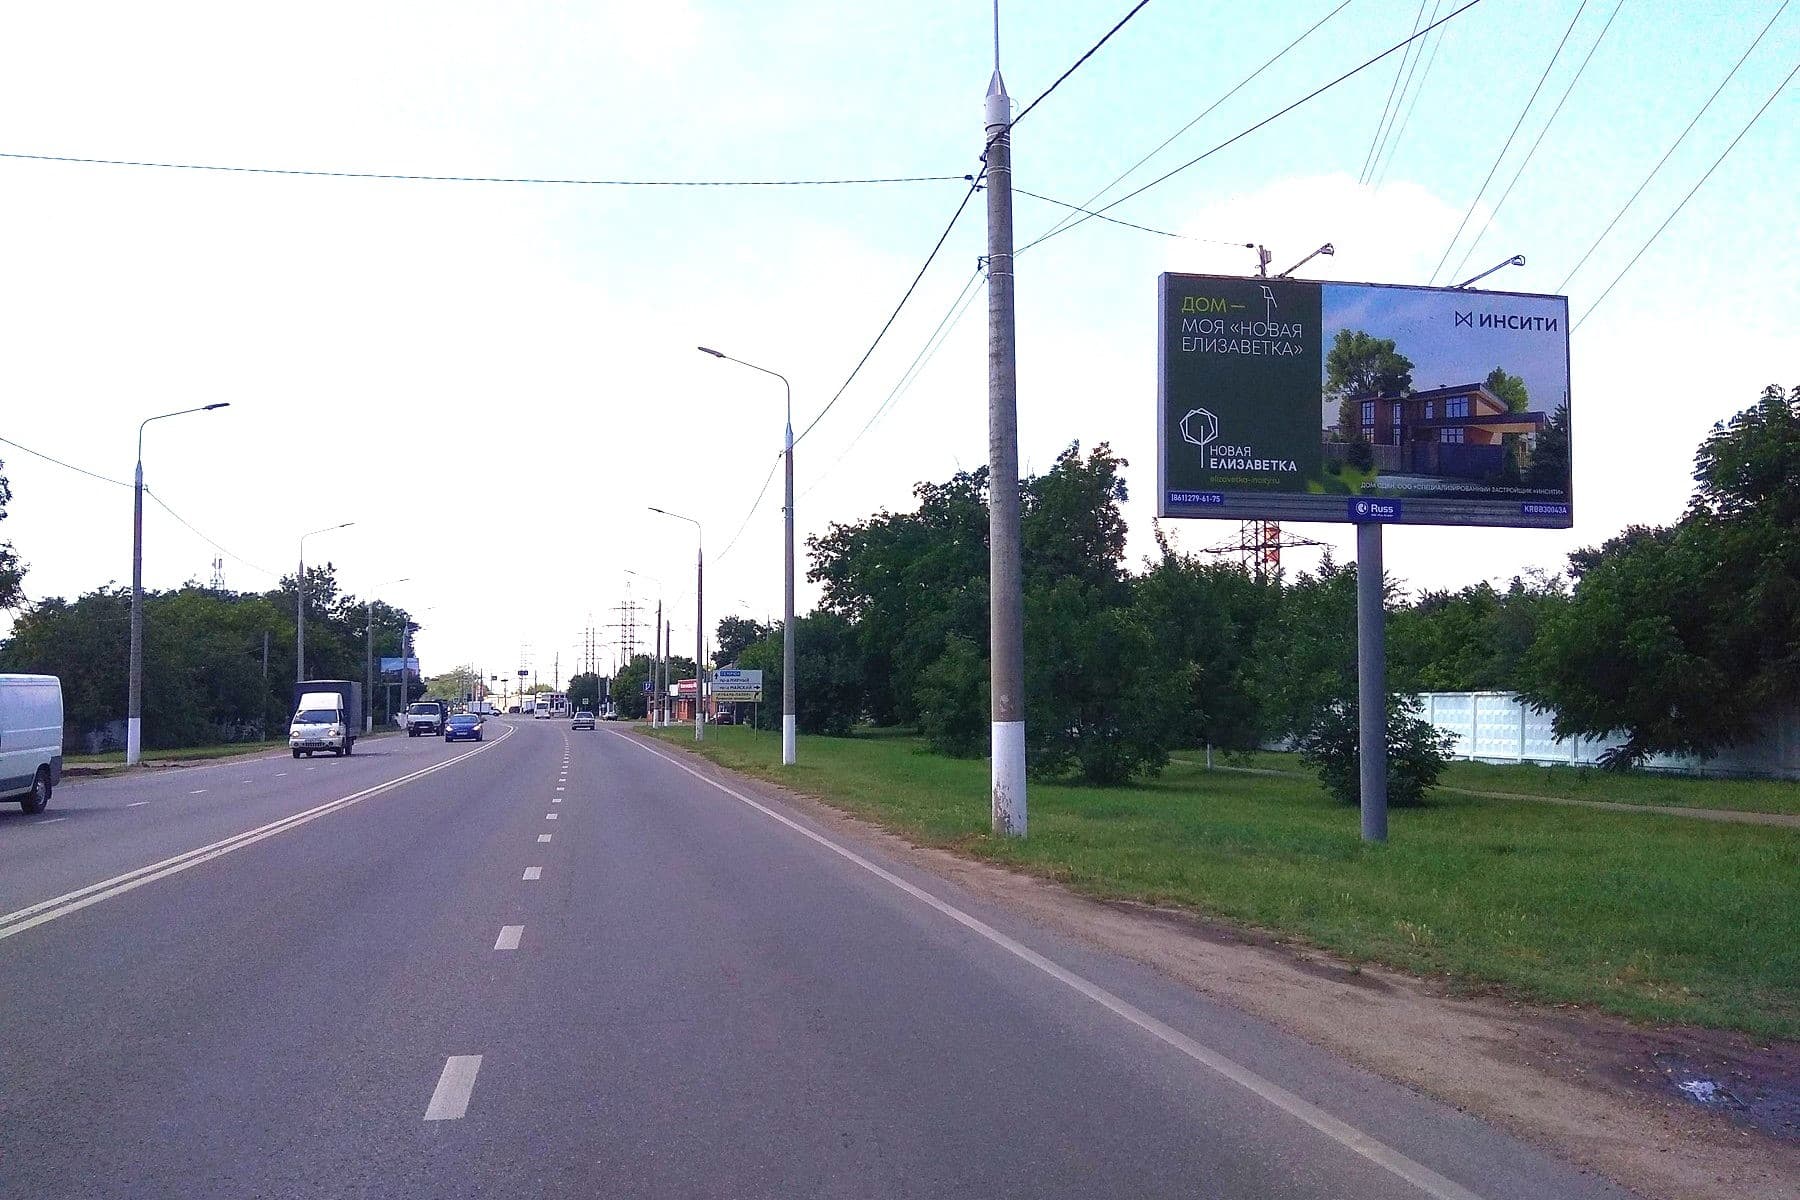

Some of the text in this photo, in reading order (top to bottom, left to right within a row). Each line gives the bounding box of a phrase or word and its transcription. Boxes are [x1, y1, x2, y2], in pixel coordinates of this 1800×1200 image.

[1181, 297, 1227, 314] ДОМ
[1181, 318, 1303, 339] МОЯ «НОВАЯ
[1479, 313, 1558, 332] ИНСИТИ
[1181, 336, 1304, 357] ЕЛИЗАВЕТКА»
[1209, 445, 1252, 457] НОВАЯ
[1209, 458, 1298, 472] ЕЛИЗАВЕТКА
[1370, 503, 1394, 513] Russ
